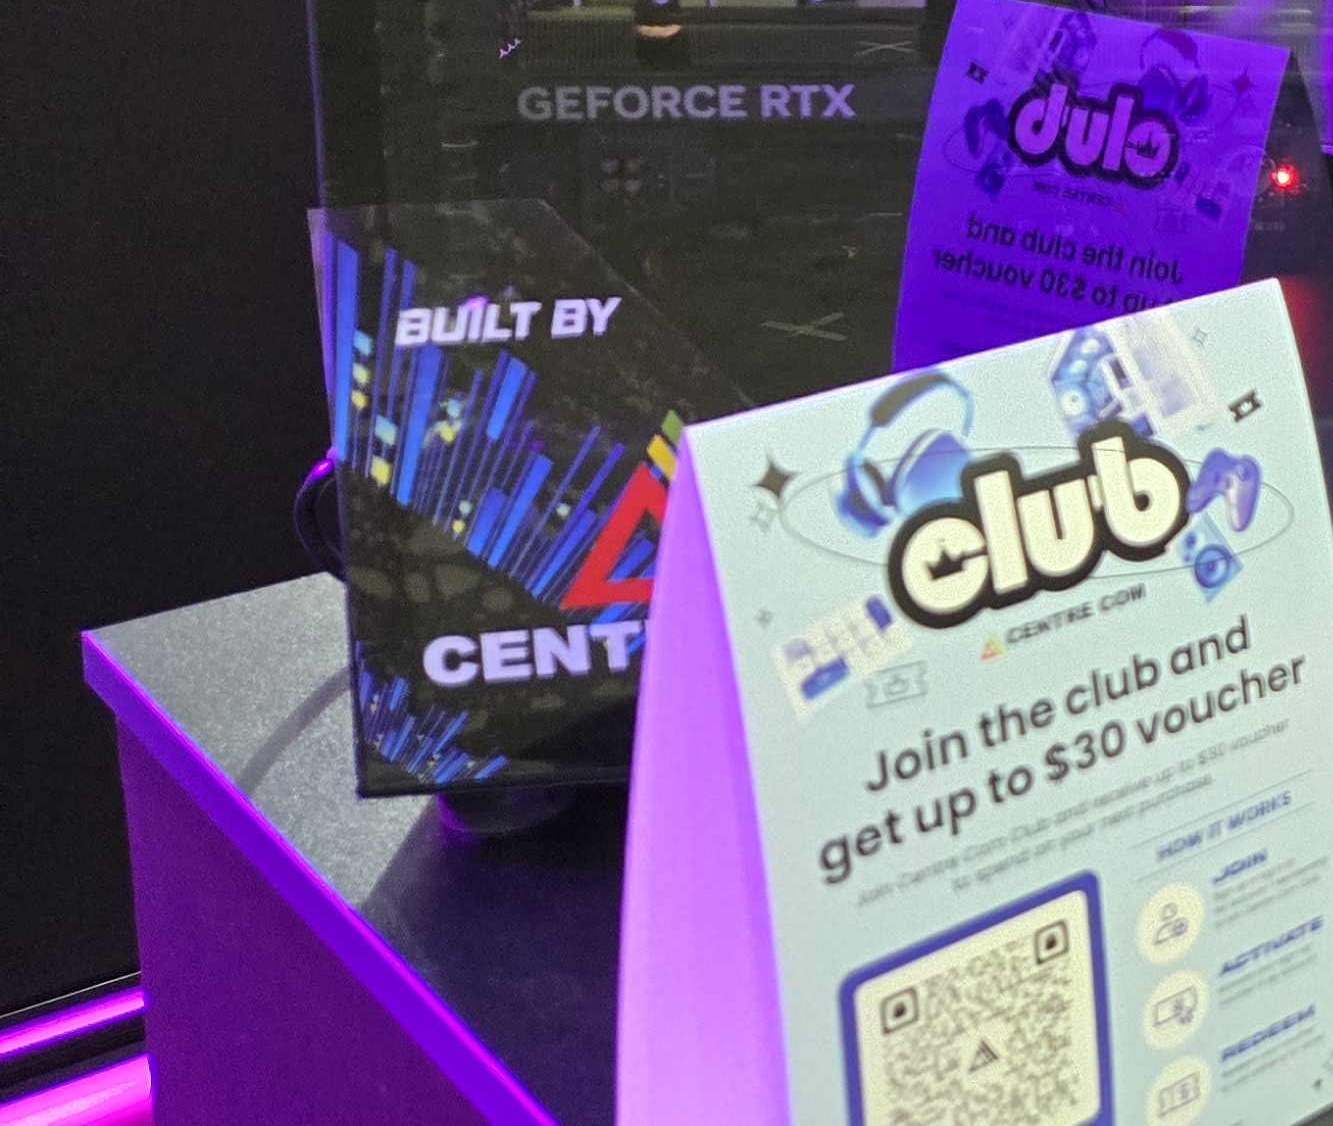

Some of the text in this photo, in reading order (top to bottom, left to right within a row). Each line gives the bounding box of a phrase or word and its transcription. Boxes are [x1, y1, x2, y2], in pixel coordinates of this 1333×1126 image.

[517, 83, 856, 122] GEFORCE RTX
[395, 297, 622, 347] BUILT BY
[897, 429, 1186, 622] club
[1006, 582, 1148, 646] CENTRE COM
[423, 619, 648, 687] CENT
[865, 613, 1250, 792] Join the club and
[1229, 717, 1291, 755] voucher
[819, 654, 1307, 886] get up to $30 voucher
[1157, 790, 1292, 862] HOW IT WORKS
[1212, 849, 1268, 885] JOIN
[1220, 914, 1324, 977] ACTIVATE
[1220, 1004, 1316, 1064] REDEEM
